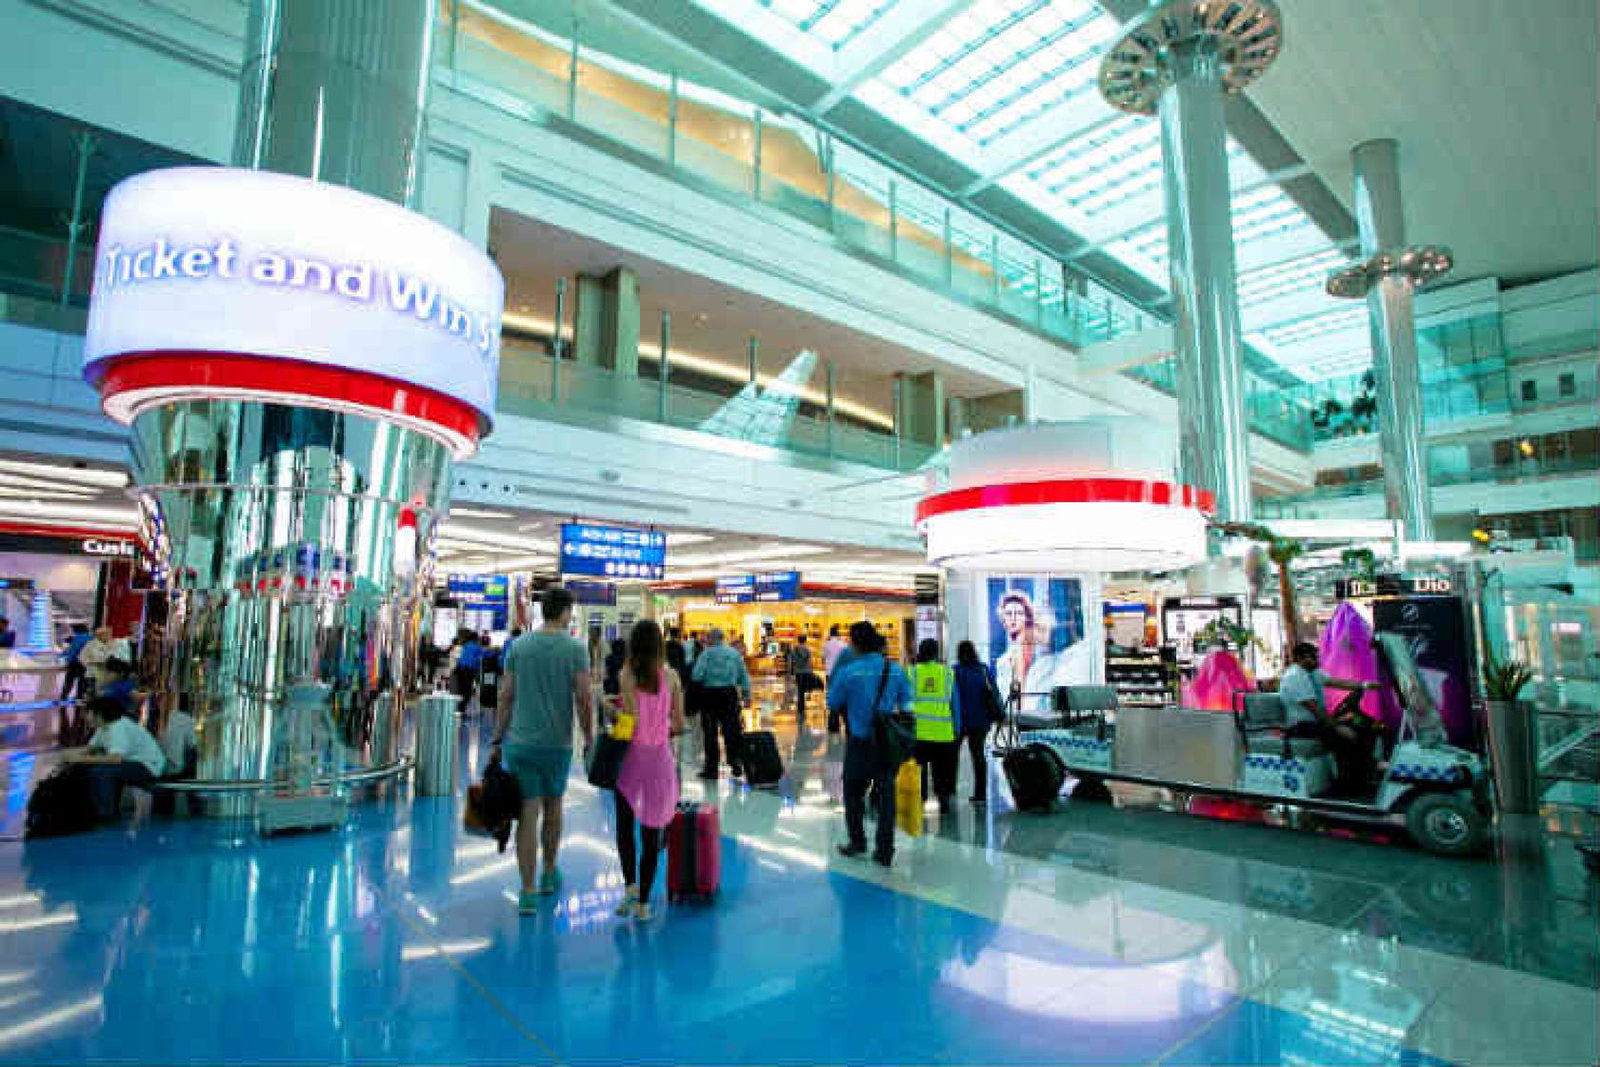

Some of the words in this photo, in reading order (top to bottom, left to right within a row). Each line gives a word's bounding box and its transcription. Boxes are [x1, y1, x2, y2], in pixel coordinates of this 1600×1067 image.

[106, 237, 235, 287] Ticket
[252, 250, 372, 299] and
[387, 269, 471, 340] Win
